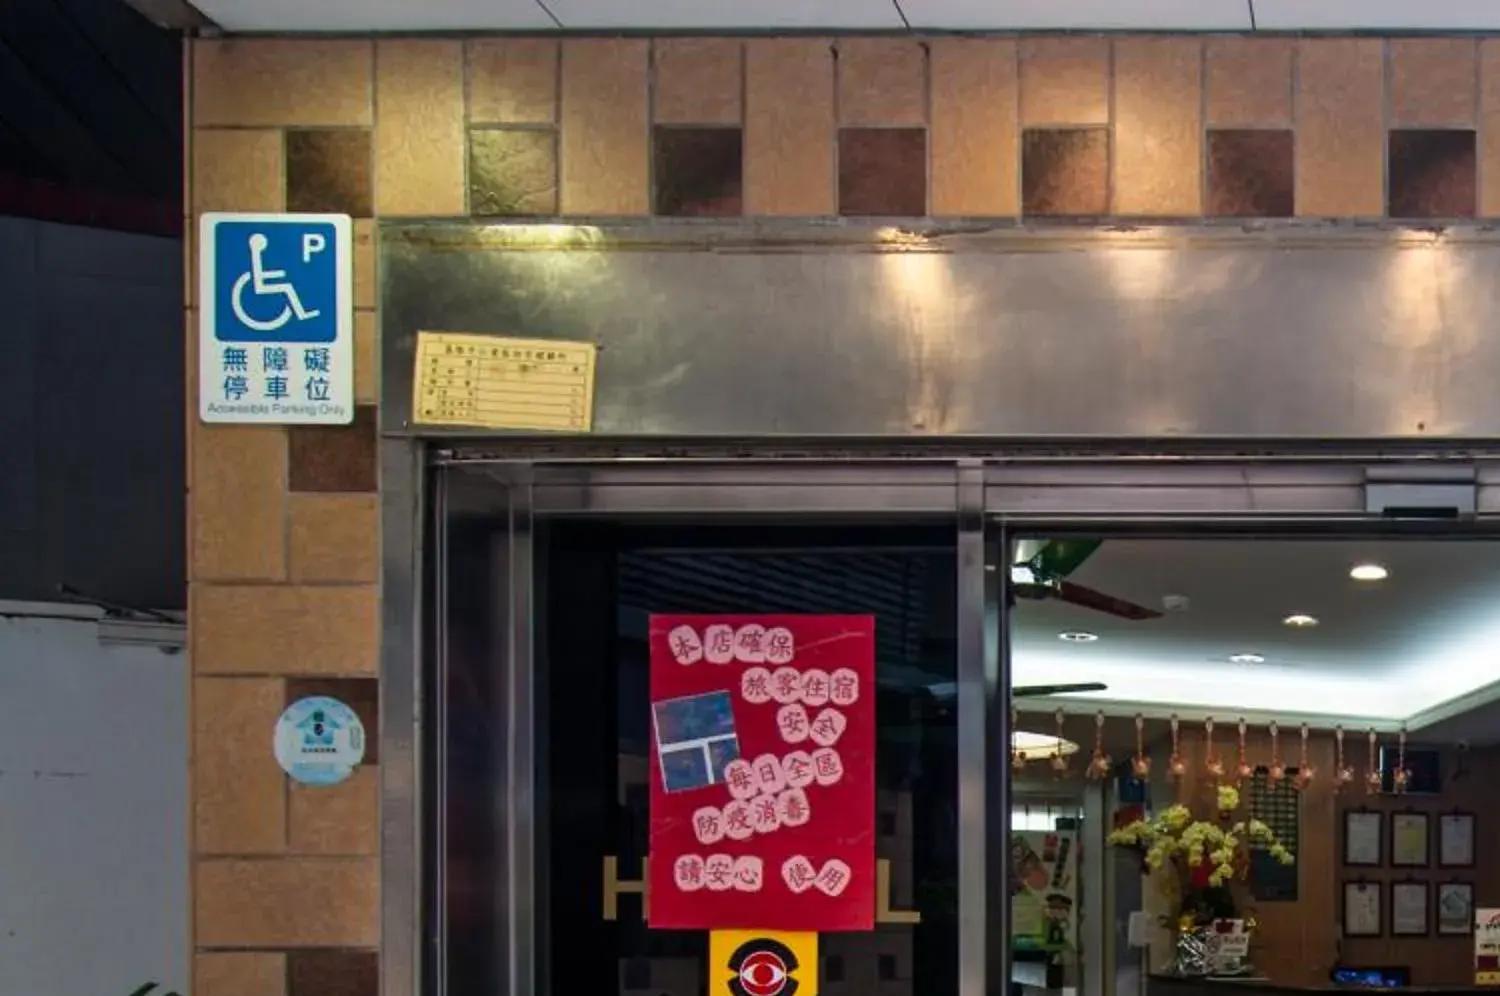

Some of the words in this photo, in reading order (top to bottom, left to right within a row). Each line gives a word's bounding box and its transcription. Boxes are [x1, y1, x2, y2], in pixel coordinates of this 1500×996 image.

[302, 233, 326, 263] P
[223, 346, 332, 373] 無障礙
[223, 375, 332, 401] 停車位
[207, 403, 269, 414] Accessible
[272, 404, 317, 416] Parking
[320, 404, 346, 416] Only
[675, 629, 792, 660] 本店確保
[745, 672, 856, 699] 旅客住宿
[780, 710, 839, 740] 安全
